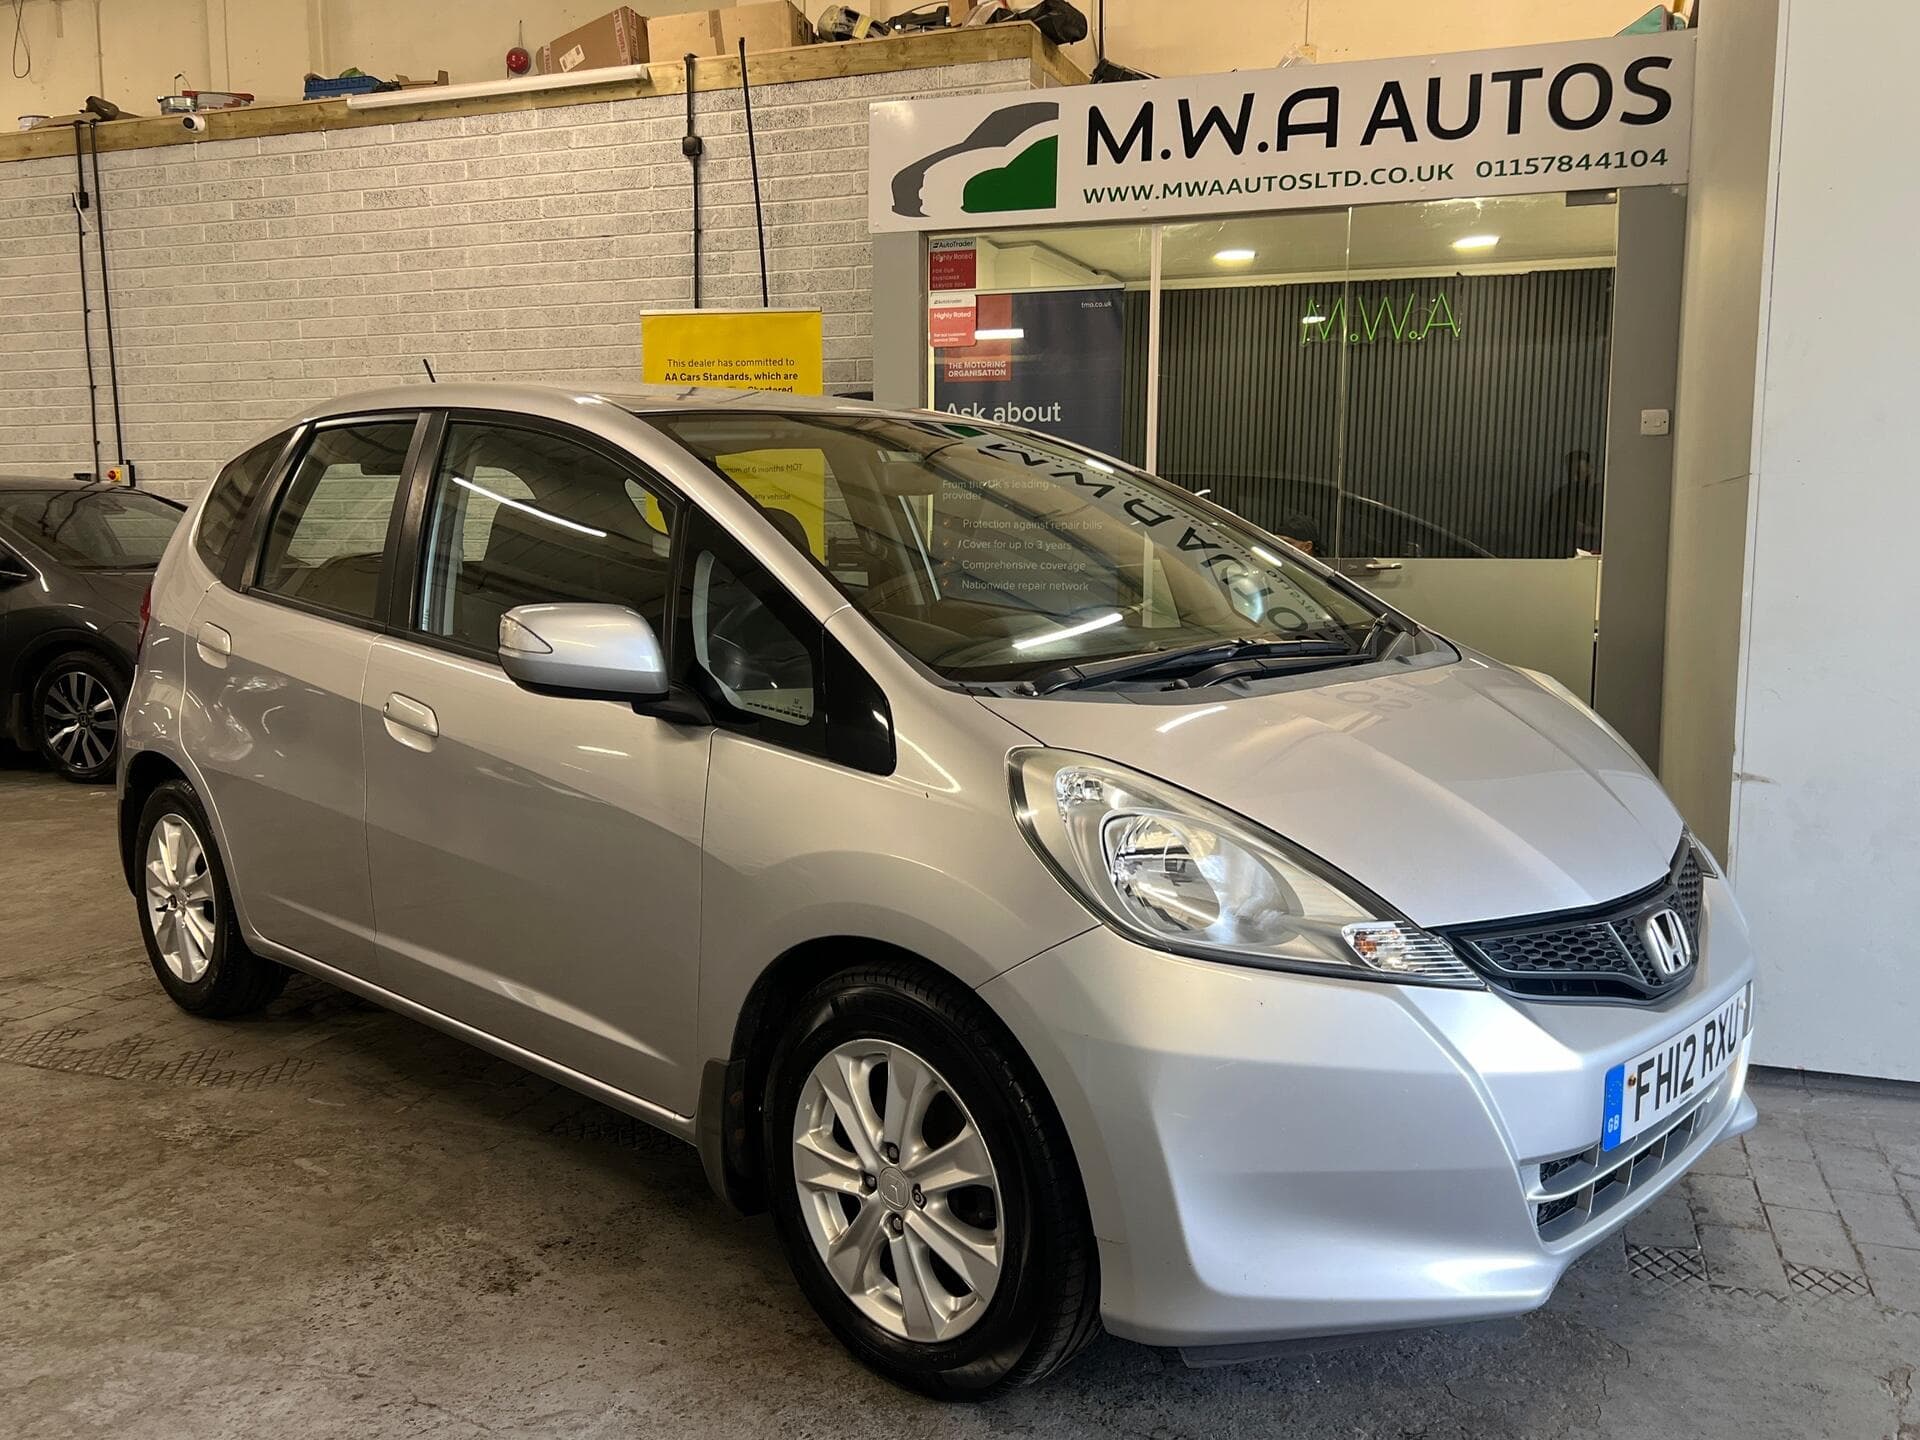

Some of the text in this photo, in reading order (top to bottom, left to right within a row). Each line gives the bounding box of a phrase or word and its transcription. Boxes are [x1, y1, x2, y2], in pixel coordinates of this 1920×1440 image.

[1087, 56, 1672, 165] M.W.A AUTOS
[1083, 149, 1668, 203] WWW.MWAAUTOSLTD.CO.UK 01157844104
[933, 312, 952, 320] Highly
[1302, 292, 1459, 345] M.W.A
[667, 358, 795, 367] This dealer has committed to
[964, 361, 1006, 369] MOTORING
[665, 373, 678, 381] AA
[680, 373, 700, 381] Cars
[703, 372, 752, 381] Standards,
[754, 372, 781, 380] which
[948, 369, 1007, 377] ORGANISATION
[993, 402, 1061, 422] about
[942, 481, 967, 489] From
[1012, 480, 1049, 491] leading
[963, 519, 1103, 531] Protection against repair bills
[962, 539, 1072, 552] Cover for up to 3 years
[962, 560, 1086, 572] Comprehensive coverage
[962, 580, 1089, 592] Nationwide repair network
[1634, 997, 1741, 1122] FH12 RXU
[1608, 1114, 1620, 1134] GB
